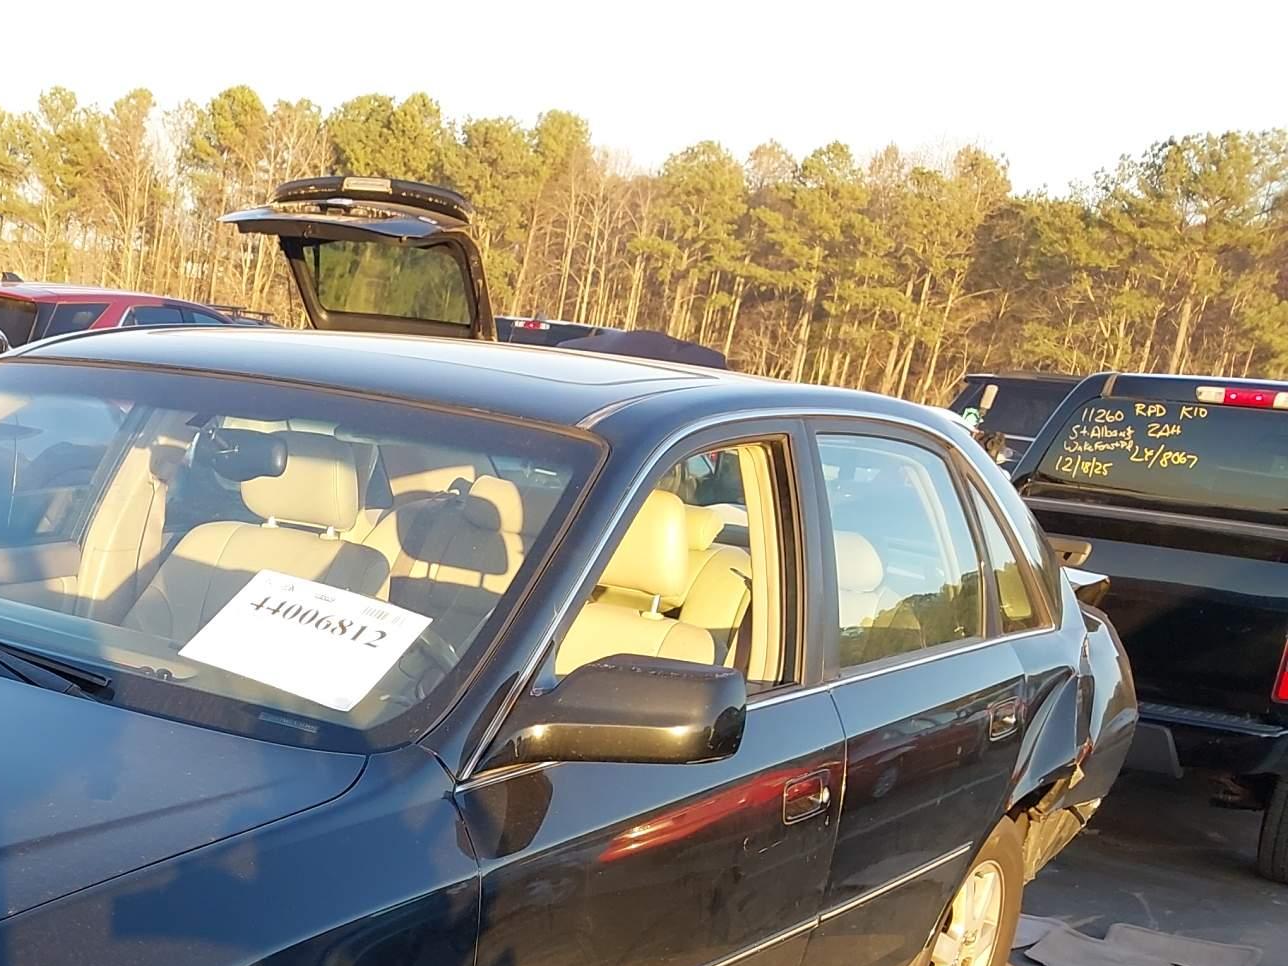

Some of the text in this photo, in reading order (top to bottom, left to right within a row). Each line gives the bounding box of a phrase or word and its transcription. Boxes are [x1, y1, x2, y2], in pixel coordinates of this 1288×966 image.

[1081, 408, 1125, 423] 11260
[1134, 403, 1167, 417] RPD
[1055, 455, 1113, 478] 12/18/25
[249, 595, 387, 648] 44006812
